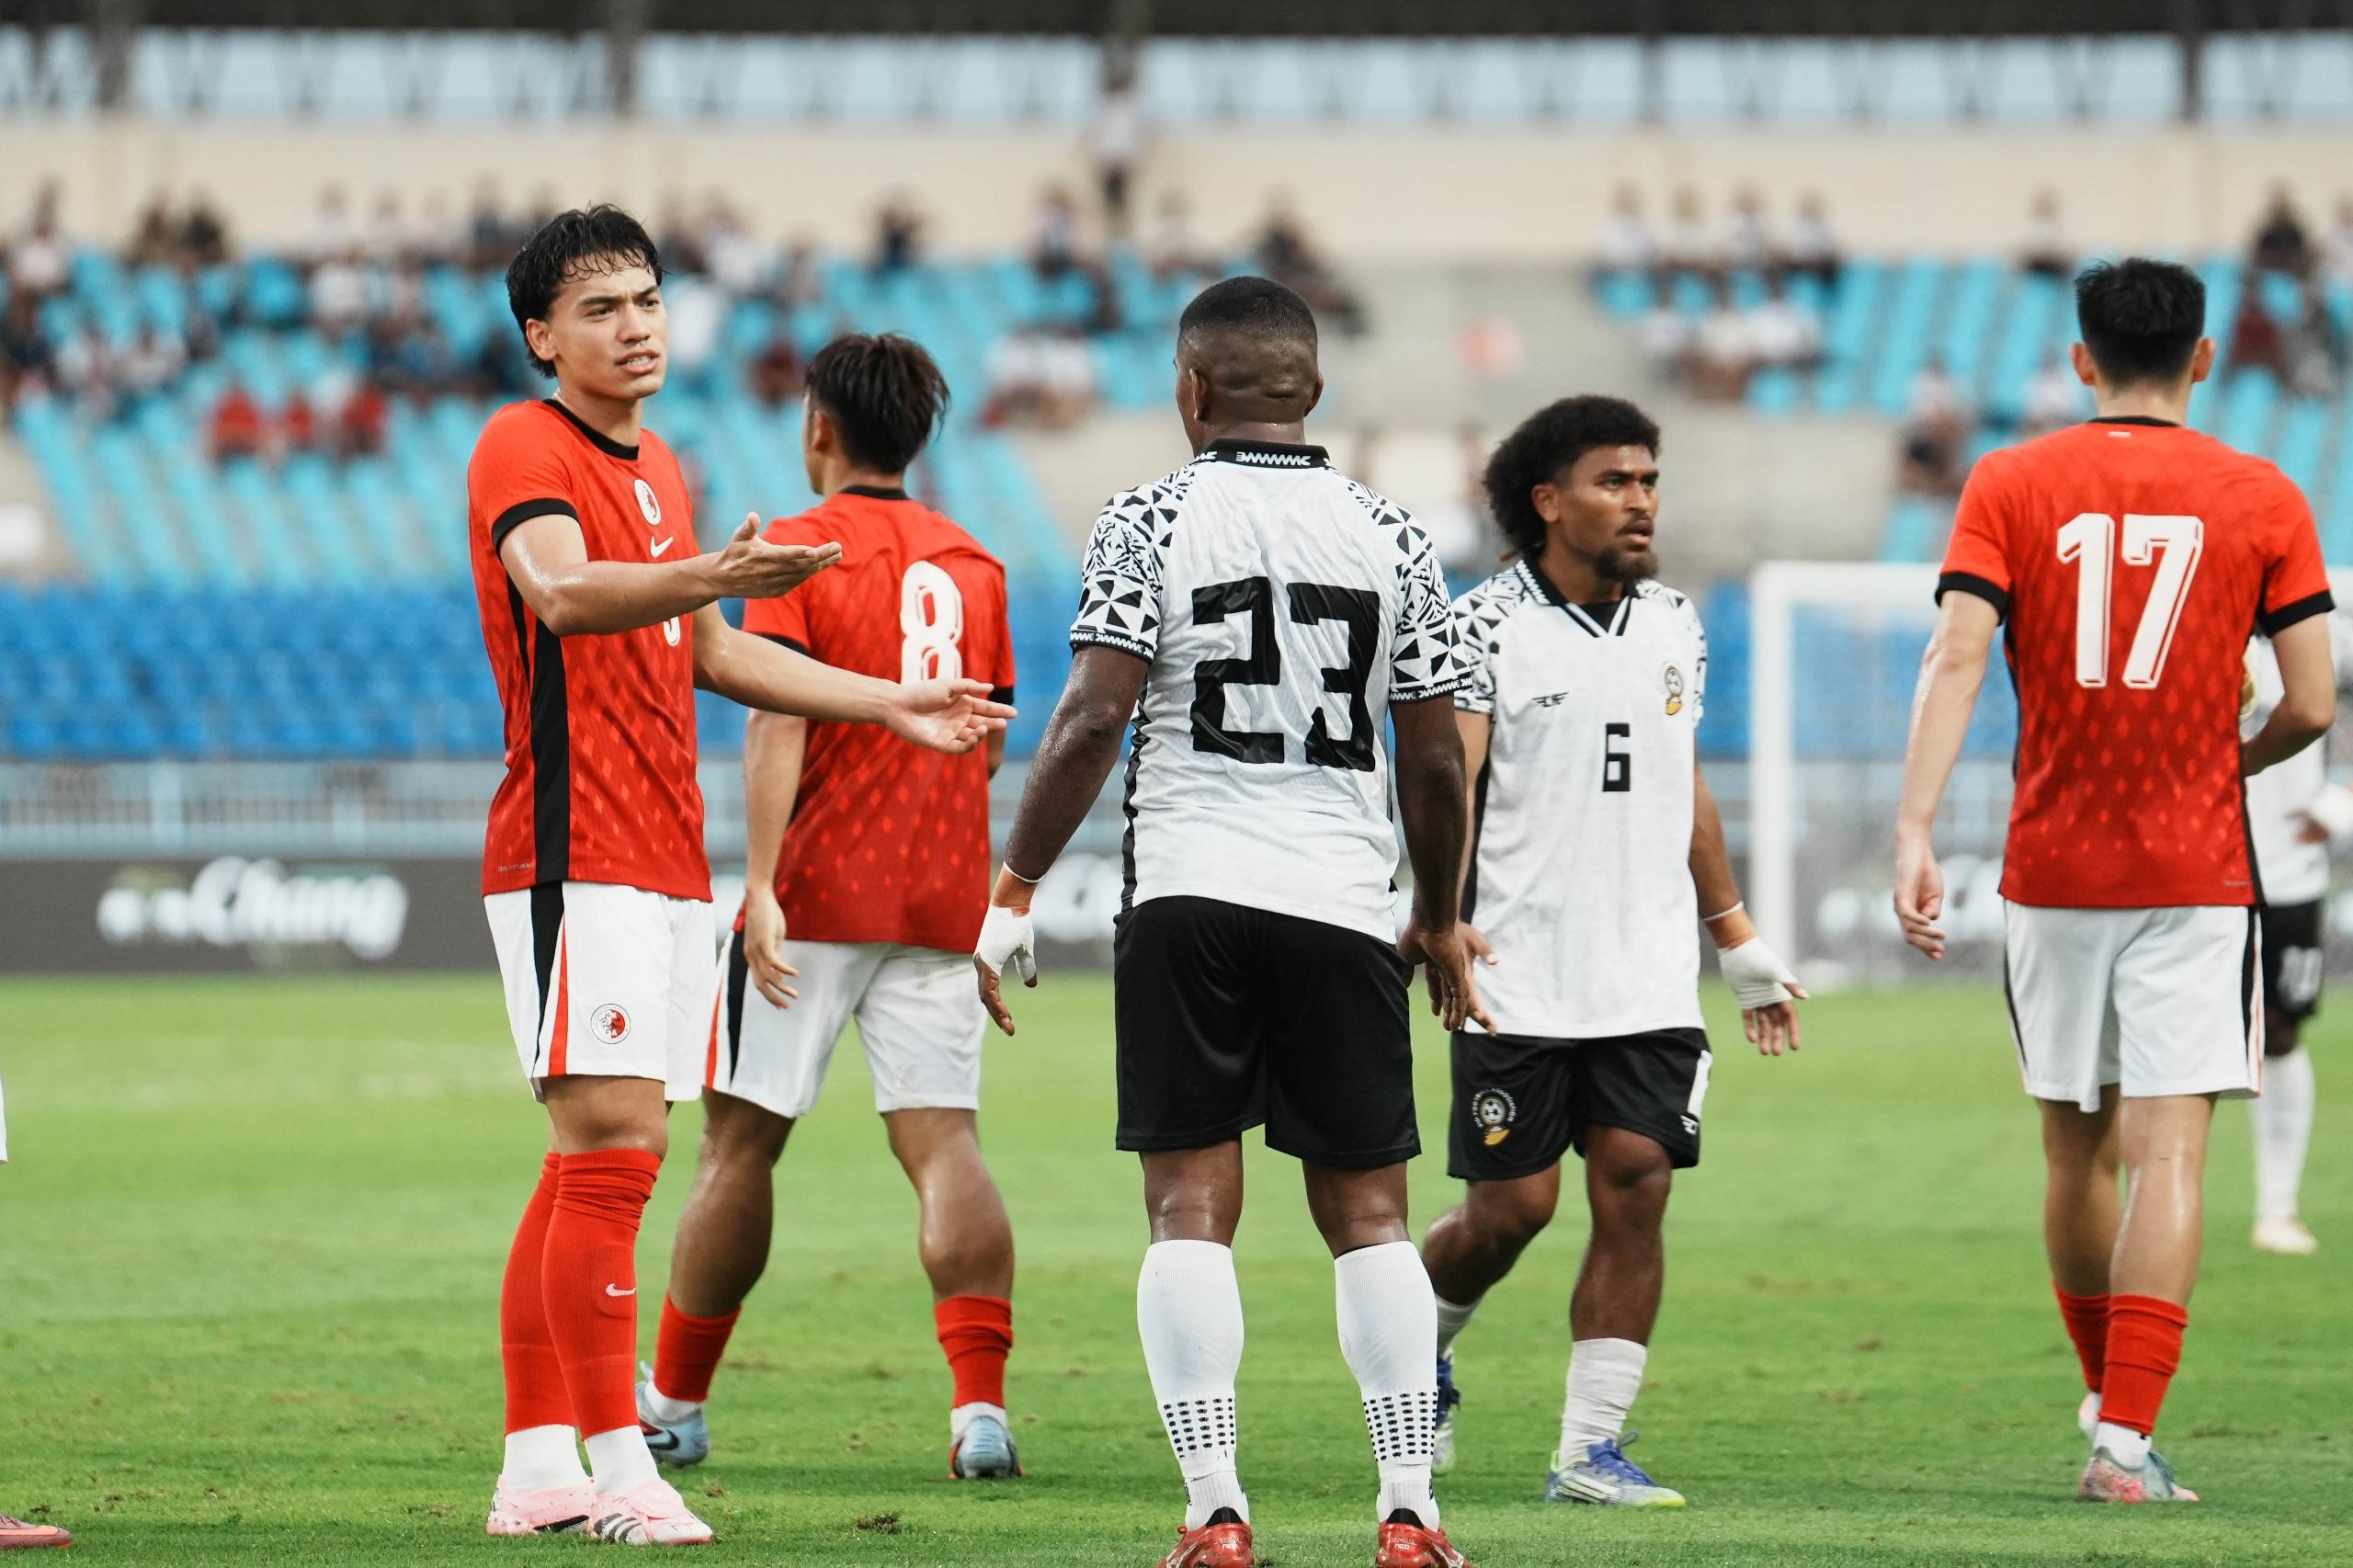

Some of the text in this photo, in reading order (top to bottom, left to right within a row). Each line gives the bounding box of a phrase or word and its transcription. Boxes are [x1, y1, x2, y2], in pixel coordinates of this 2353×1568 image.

[900, 560, 964, 684] 8
[1189, 575, 1381, 773] 23
[2056, 512, 2204, 689] 17
[1602, 722, 1631, 792] 6
